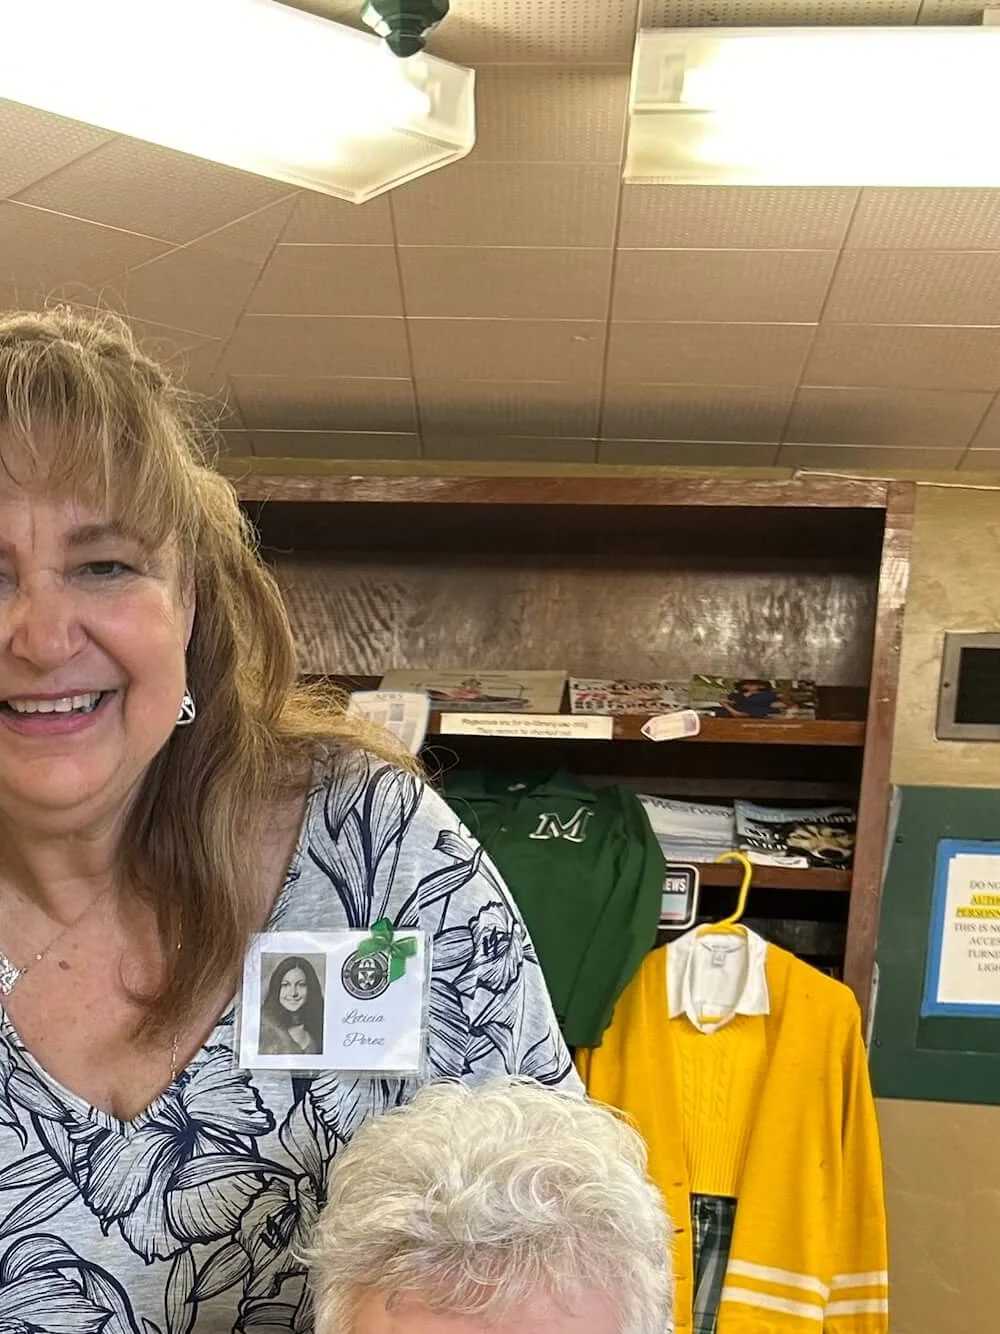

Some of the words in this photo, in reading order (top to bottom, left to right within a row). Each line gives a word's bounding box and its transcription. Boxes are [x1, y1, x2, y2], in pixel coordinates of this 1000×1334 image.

[528, 806, 595, 843] M
[664, 878, 687, 892] EWS
[969, 880, 985, 890] DO
[954, 923, 976, 933] THIS
[978, 923, 988, 933] IS
[342, 1010, 385, 1025] Leticia
[342, 1032, 385, 1047] Perez
